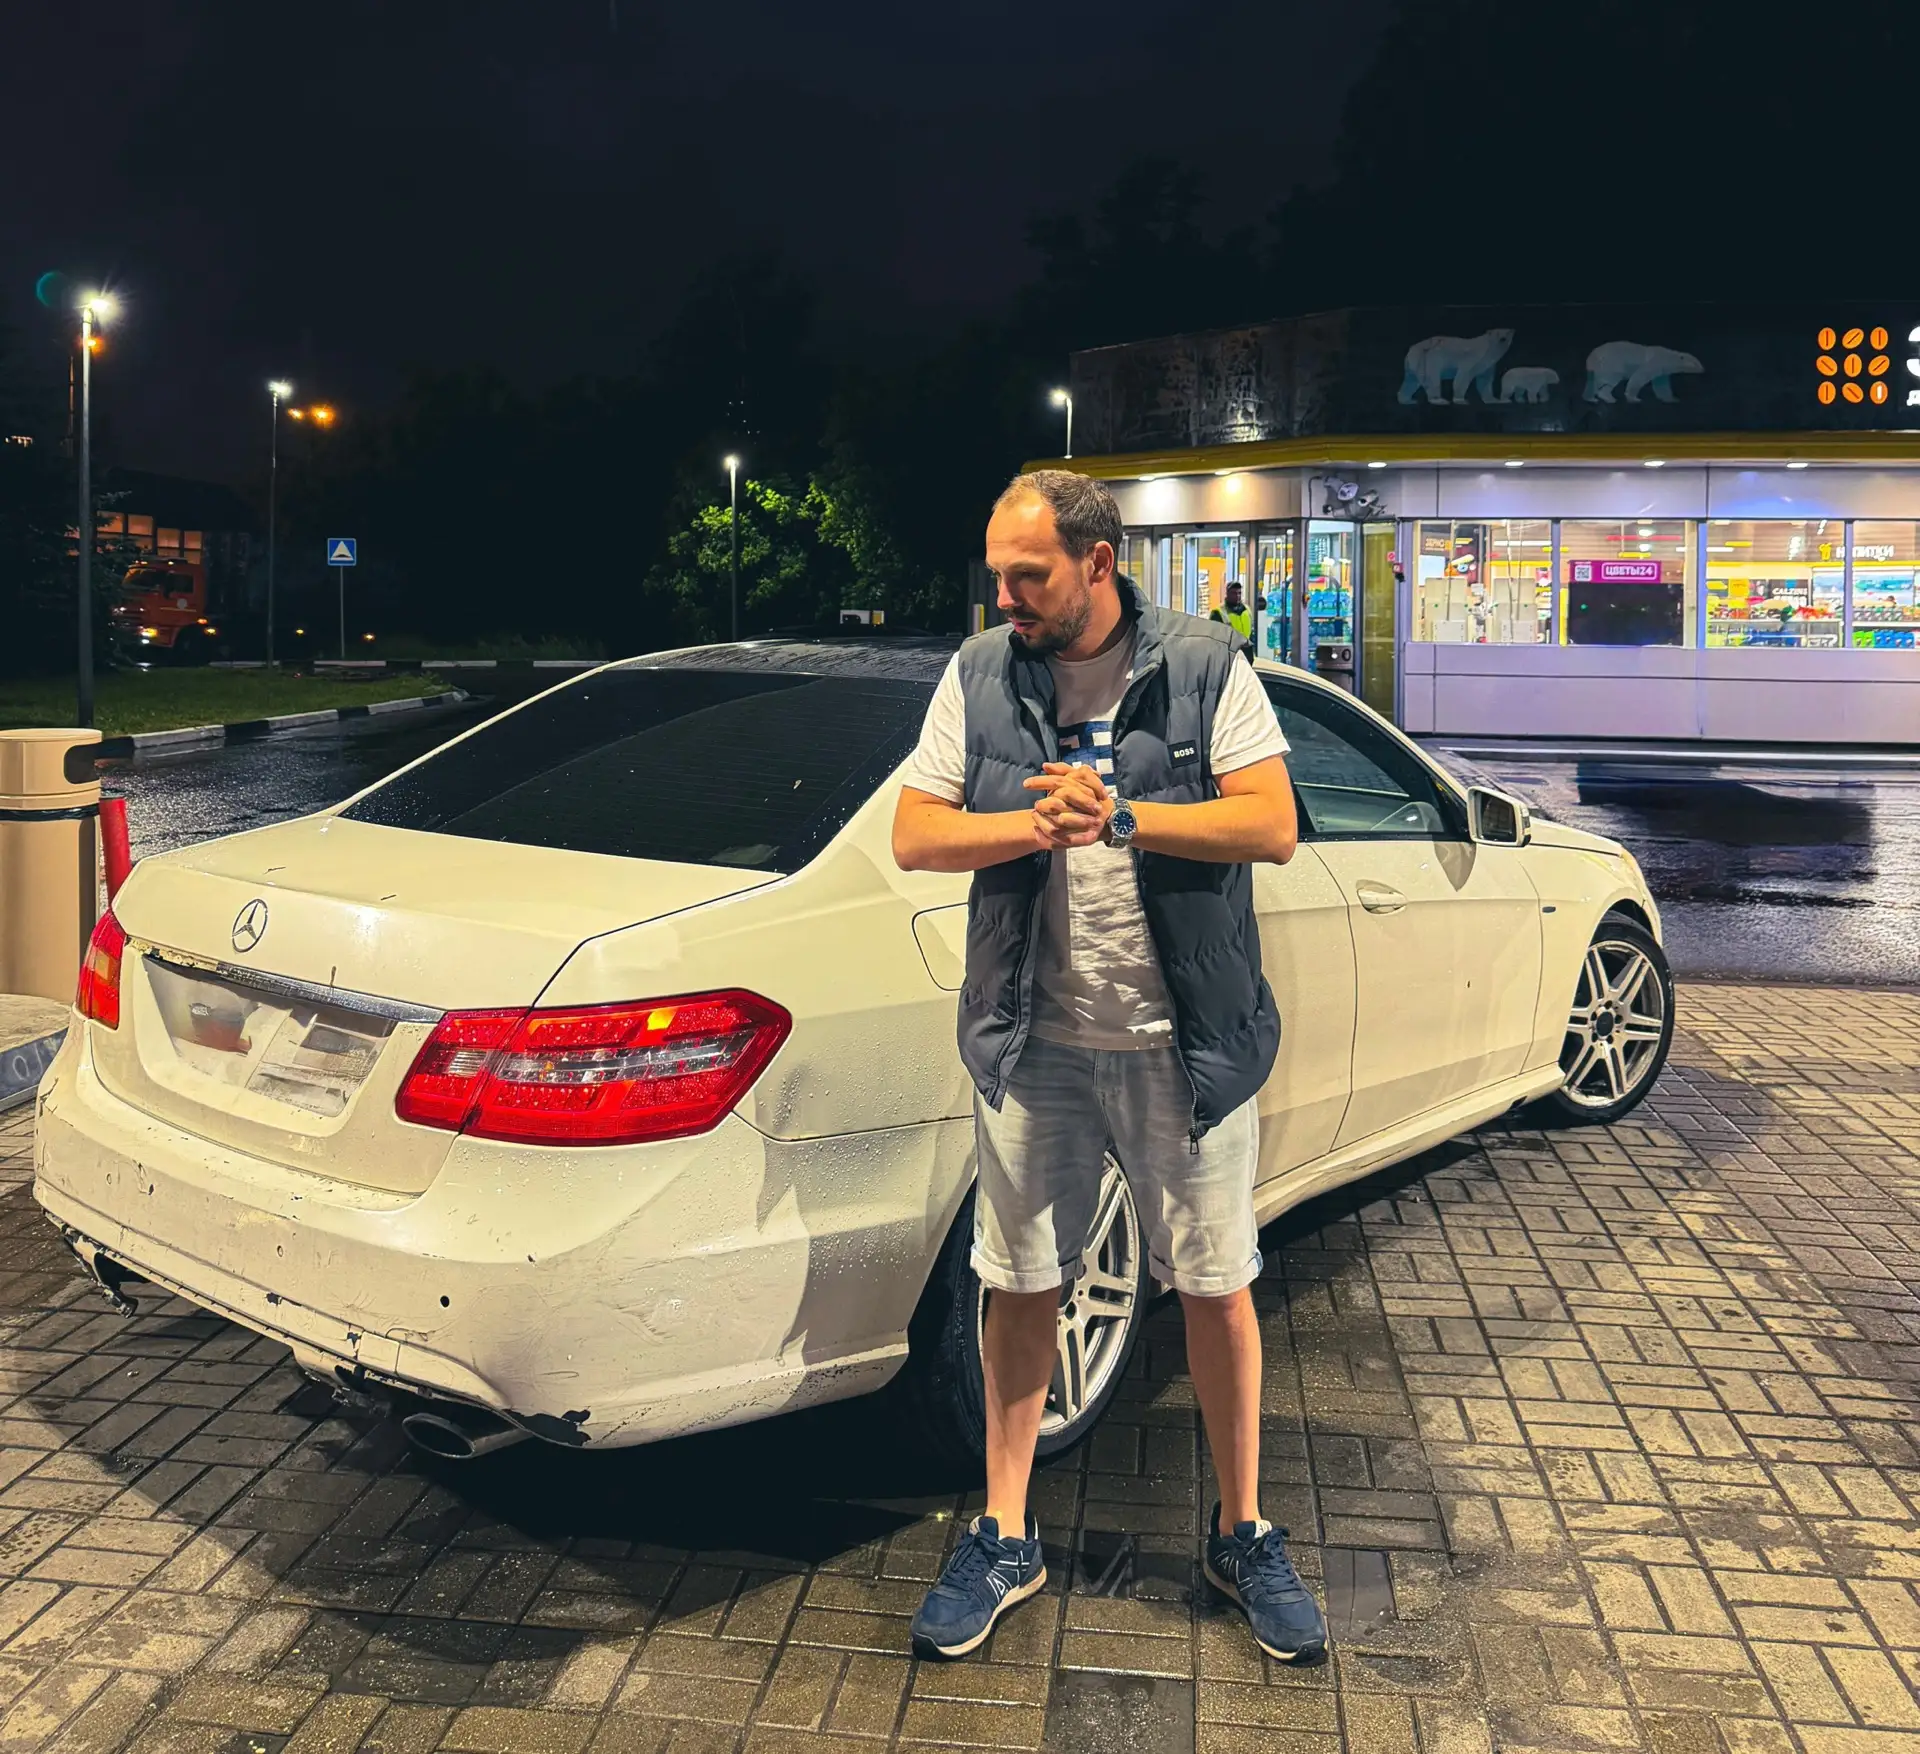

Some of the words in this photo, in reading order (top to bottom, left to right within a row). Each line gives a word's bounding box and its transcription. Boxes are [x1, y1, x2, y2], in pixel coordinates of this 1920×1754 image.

[1836, 545, 1895, 558] НПИТКИ
[1605, 565, 1653, 576] ЦВЕТЫ24
[1173, 747, 1195, 758] BOSS
